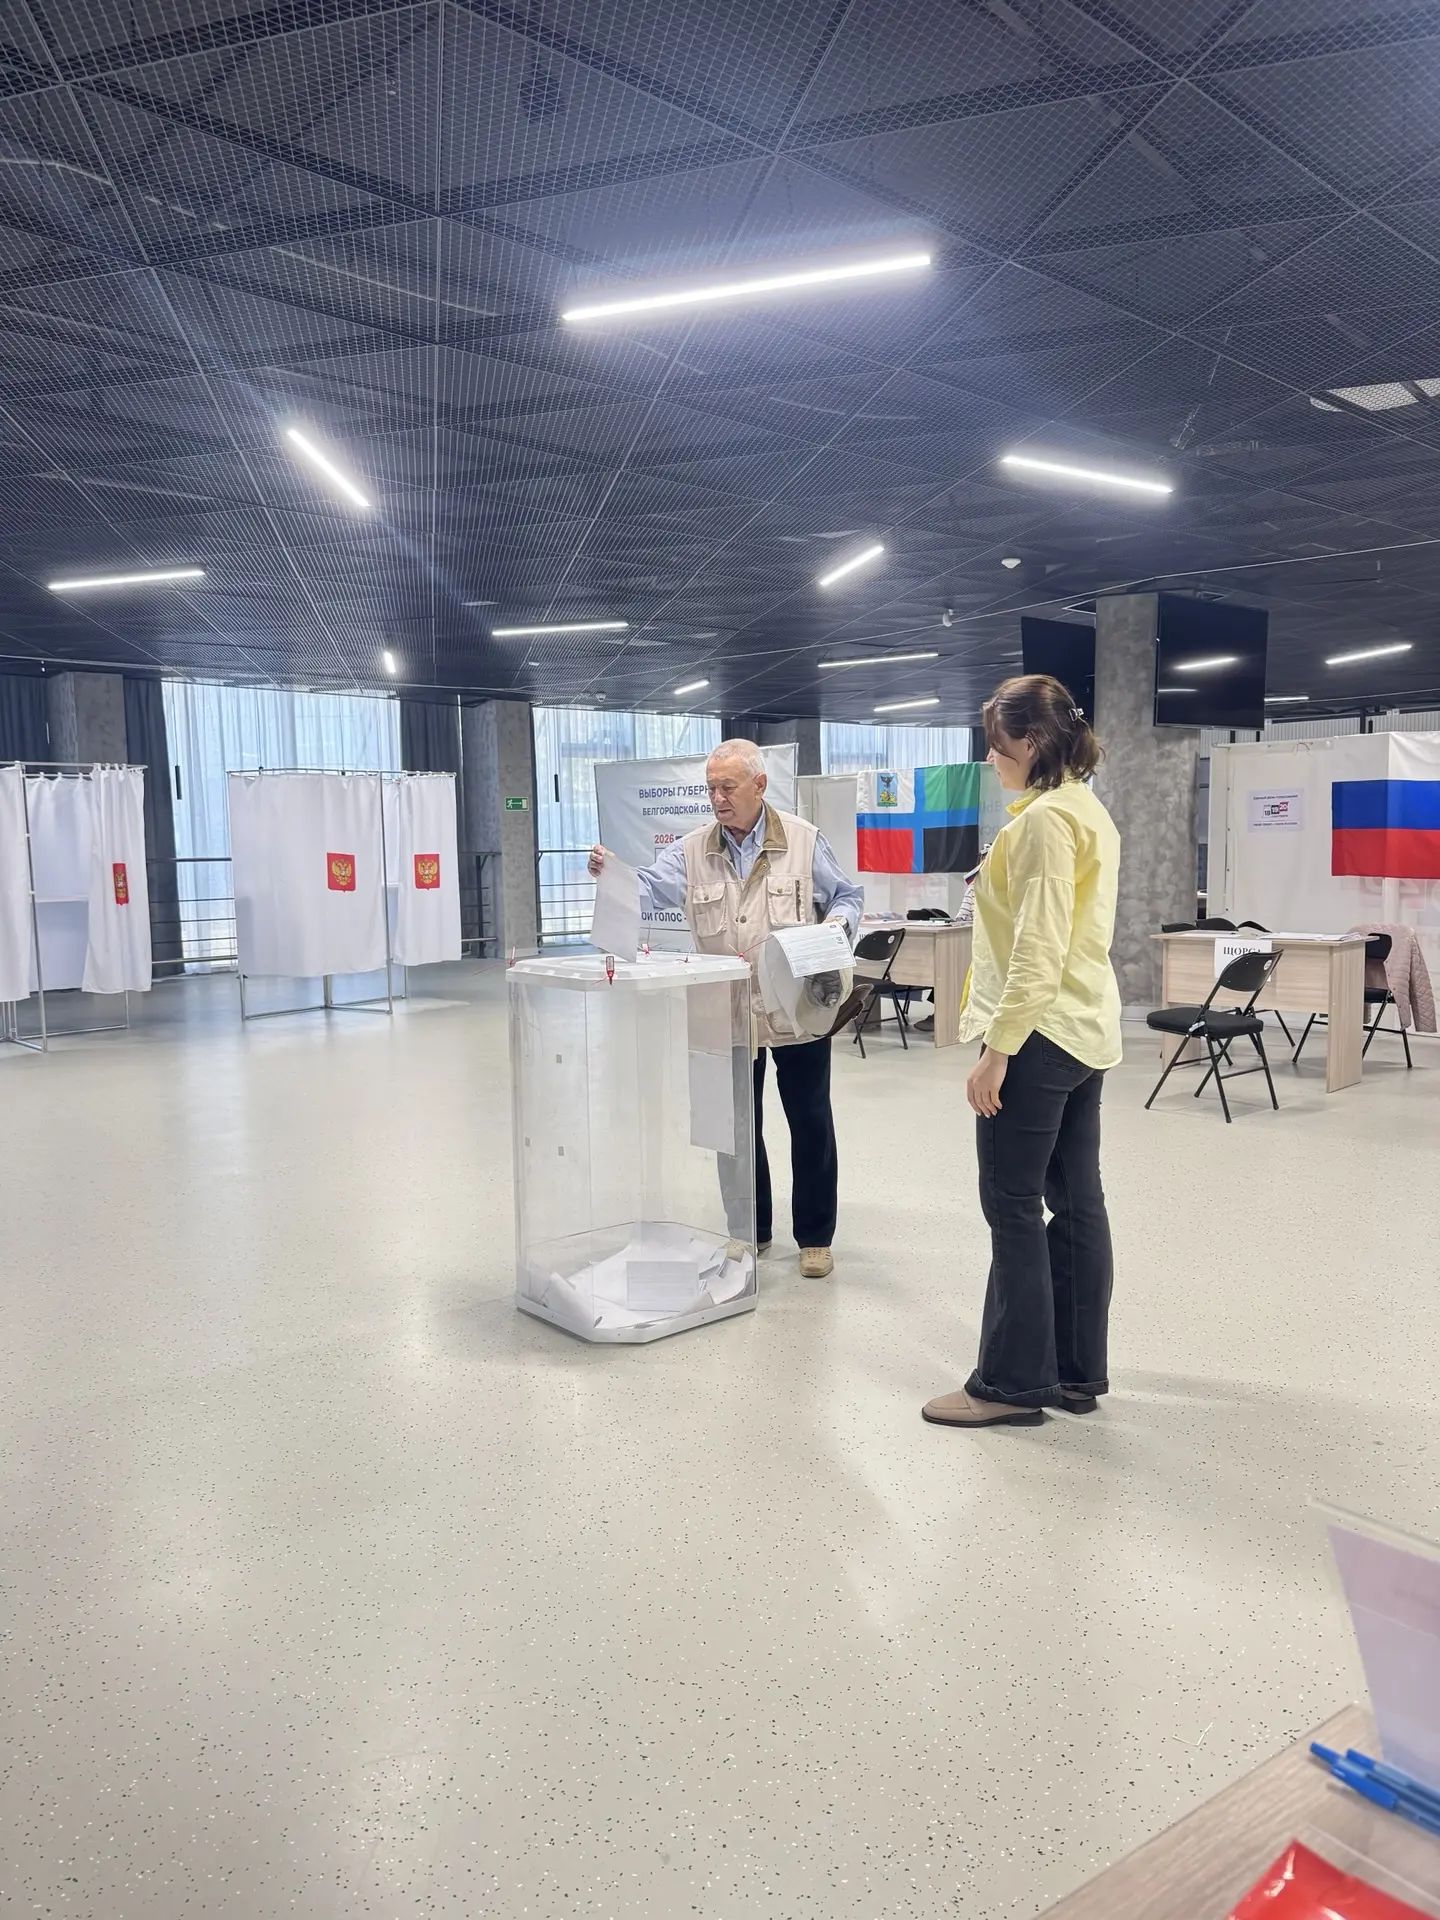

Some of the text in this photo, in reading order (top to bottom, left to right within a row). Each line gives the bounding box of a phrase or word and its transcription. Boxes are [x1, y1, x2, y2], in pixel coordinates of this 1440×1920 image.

[639, 787, 676, 799] ВЫБОРЫ
[642, 803, 714, 816] БЕЛГОРОДСКОЙ ОБ
[654, 834, 674, 844] 2026
[654, 912, 682, 922] ГОЛОС
[1223, 946, 1261, 956] ЩОРС
